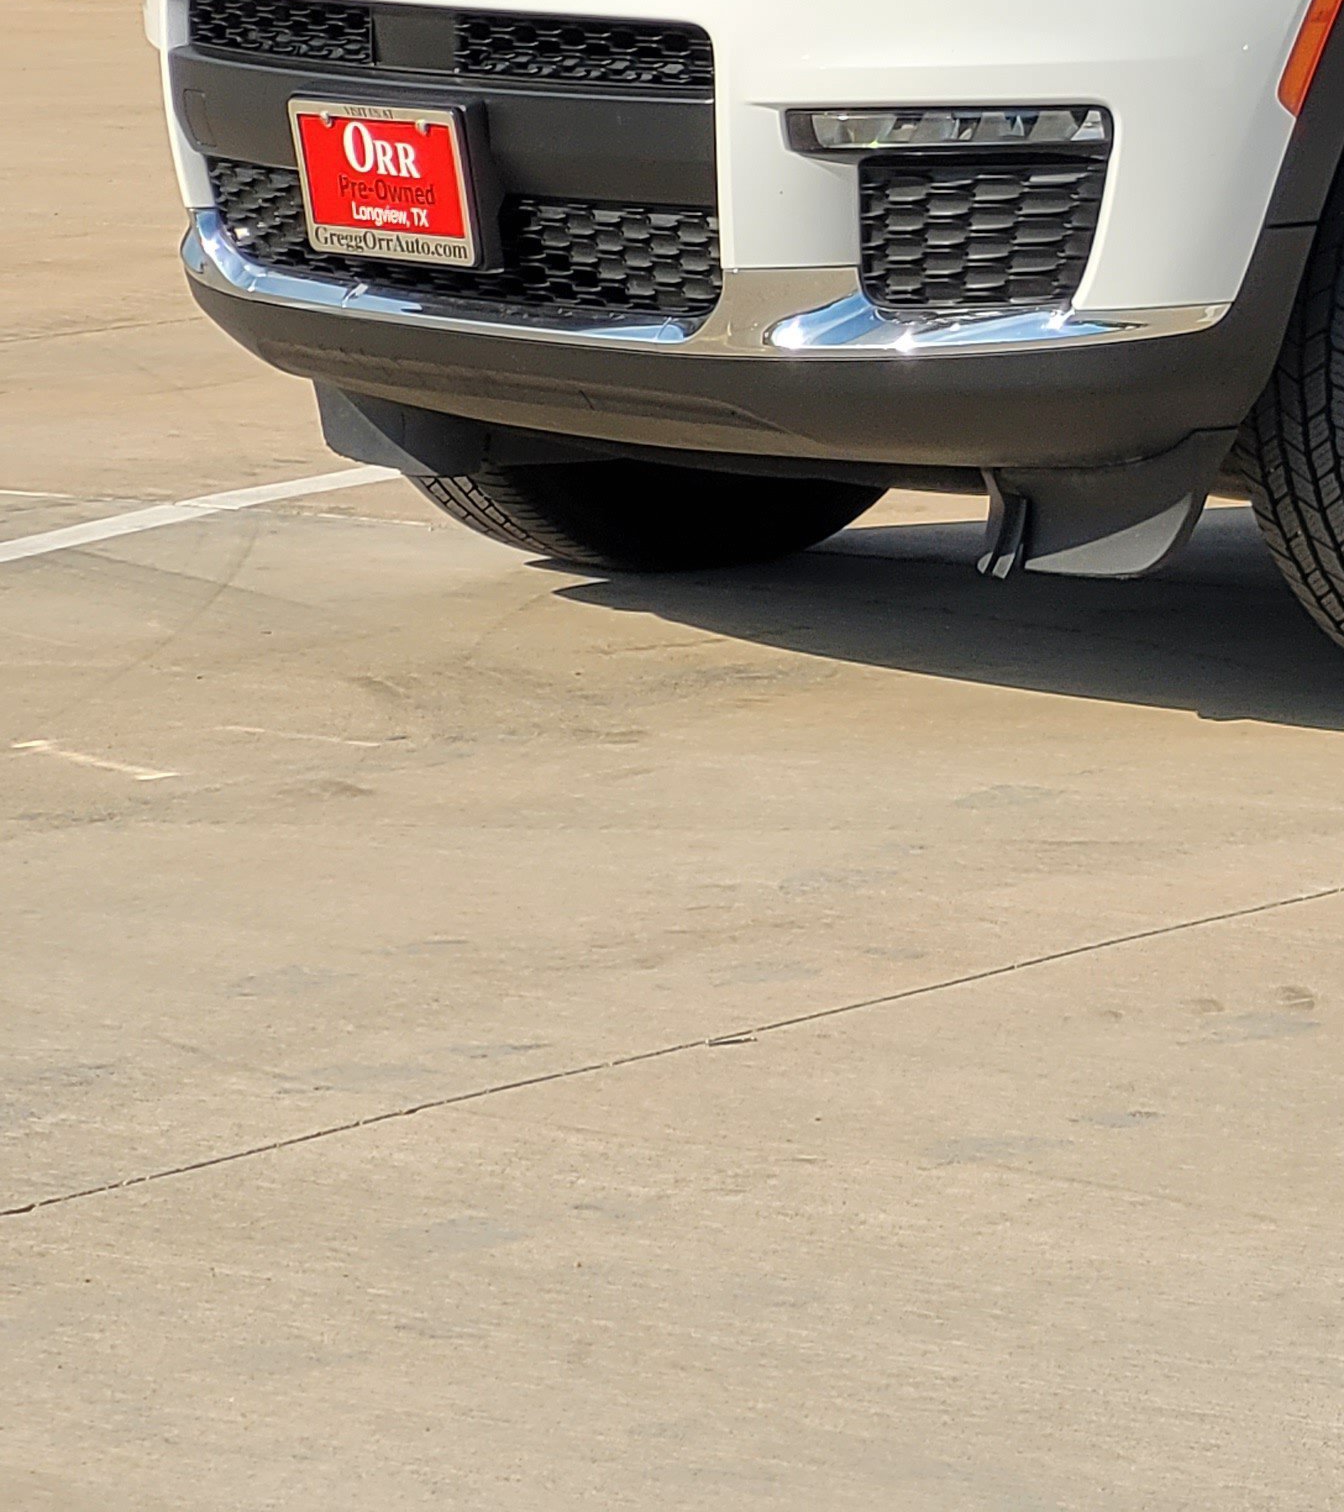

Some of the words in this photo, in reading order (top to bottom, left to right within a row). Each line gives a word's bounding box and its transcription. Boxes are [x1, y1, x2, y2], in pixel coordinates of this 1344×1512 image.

[338, 175, 436, 206] Pre-Owned
[351, 201, 411, 228] Longview,
[411, 207, 430, 228] TX
[315, 225, 468, 260] GreggOrrAuto.com
